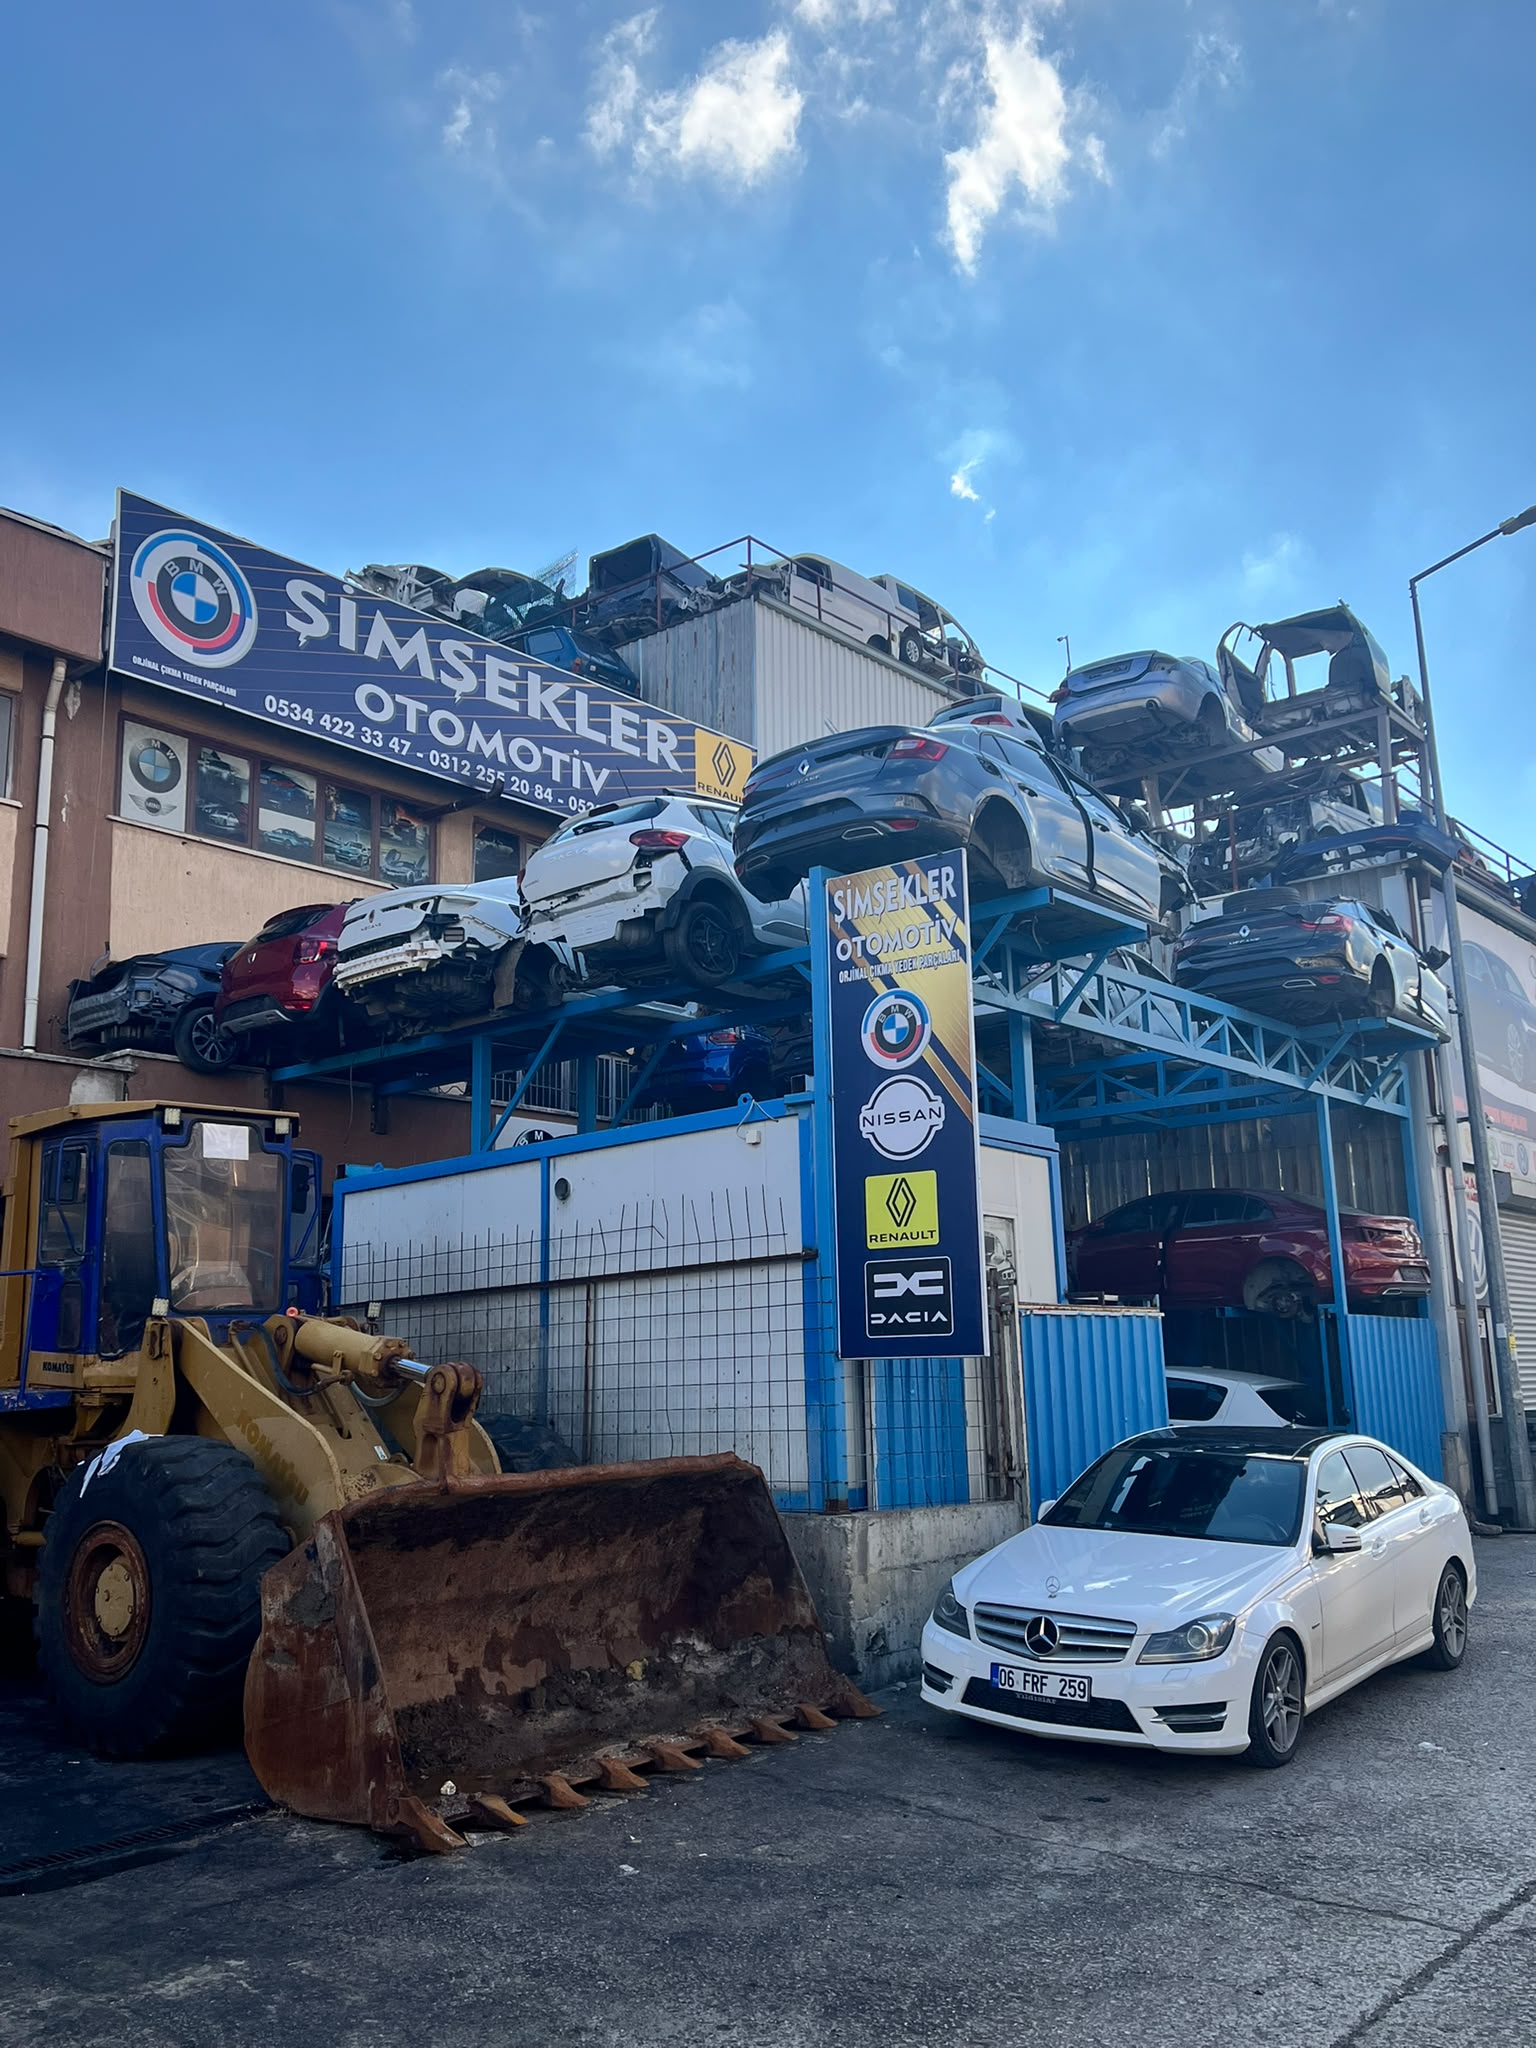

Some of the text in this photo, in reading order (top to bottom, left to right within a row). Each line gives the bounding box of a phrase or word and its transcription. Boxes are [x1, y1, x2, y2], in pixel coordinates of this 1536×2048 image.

[164, 559, 227, 596] BMW
[132, 655, 236, 697] ORJİNAL ÇIKMA YEDEK PARÇALARI
[285, 579, 683, 773] ŞİMŞEKLER
[135, 740, 176, 760] BMW
[264, 695, 314, 725] 0534
[319, 714, 355, 739] 422
[360, 726, 384, 747] 33
[388, 736, 411, 756] 47
[429, 750, 471, 777] 0312
[510, 776, 530, 795] 20
[534, 784, 553, 803] 84
[355, 683, 610, 797] OTOMOTİV
[833, 866, 957, 929] ŞİMŞEKLER
[836, 913, 958, 961] OTOMOTİV
[839, 948, 960, 983] ORJİNAL ÇIKMA YEDEK PARÇALARI
[878, 1004, 913, 1024] BMW
[862, 1106, 942, 1128] NISSAN
[869, 1230, 937, 1243] RENAULT
[870, 1310, 948, 1325] DACIA
[999, 1668, 1015, 1687] 06
[1023, 1672, 1048, 1693] FRF
[1059, 1678, 1087, 1699] 259
